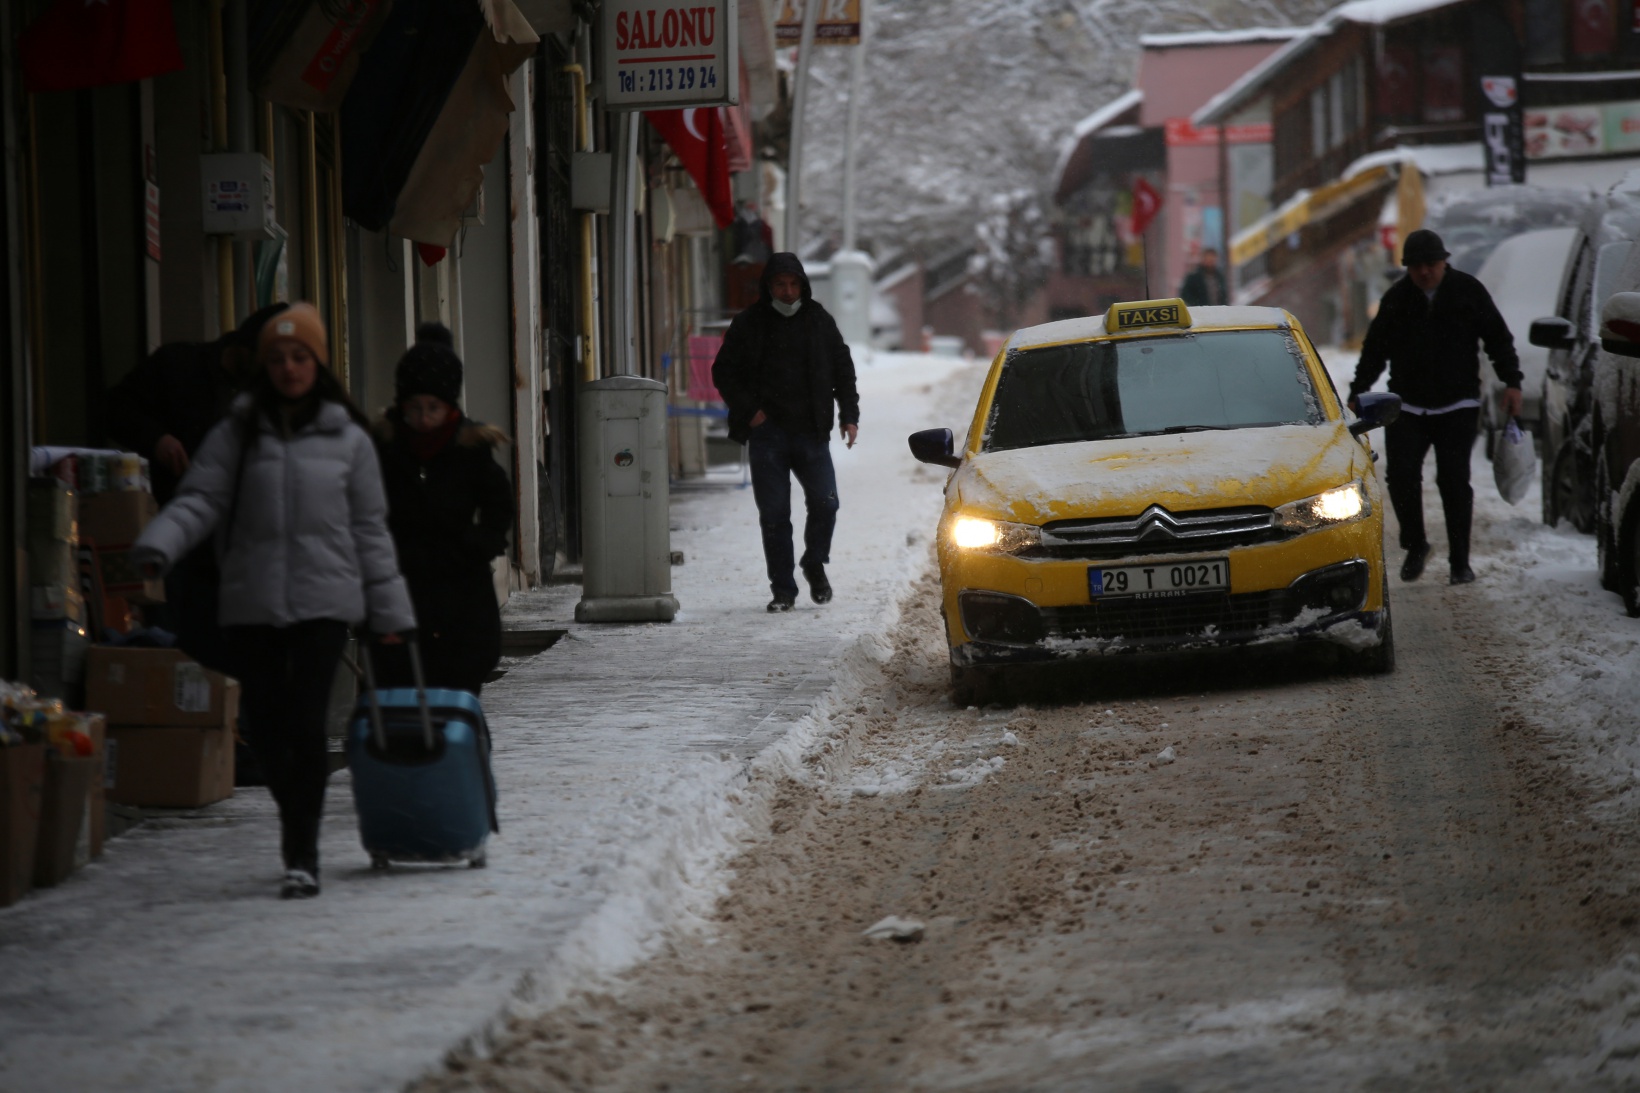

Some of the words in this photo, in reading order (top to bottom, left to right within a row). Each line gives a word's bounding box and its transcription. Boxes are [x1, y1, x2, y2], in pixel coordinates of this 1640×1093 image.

[616, 7, 716, 50] SALONU
[618, 70, 635, 92] Tel
[648, 68, 674, 91] 213
[678, 67, 695, 89] 29
[700, 66, 716, 88] 24
[1102, 571, 1129, 592] 29
[1143, 568, 1155, 589] T
[1170, 564, 1221, 587] 0021
